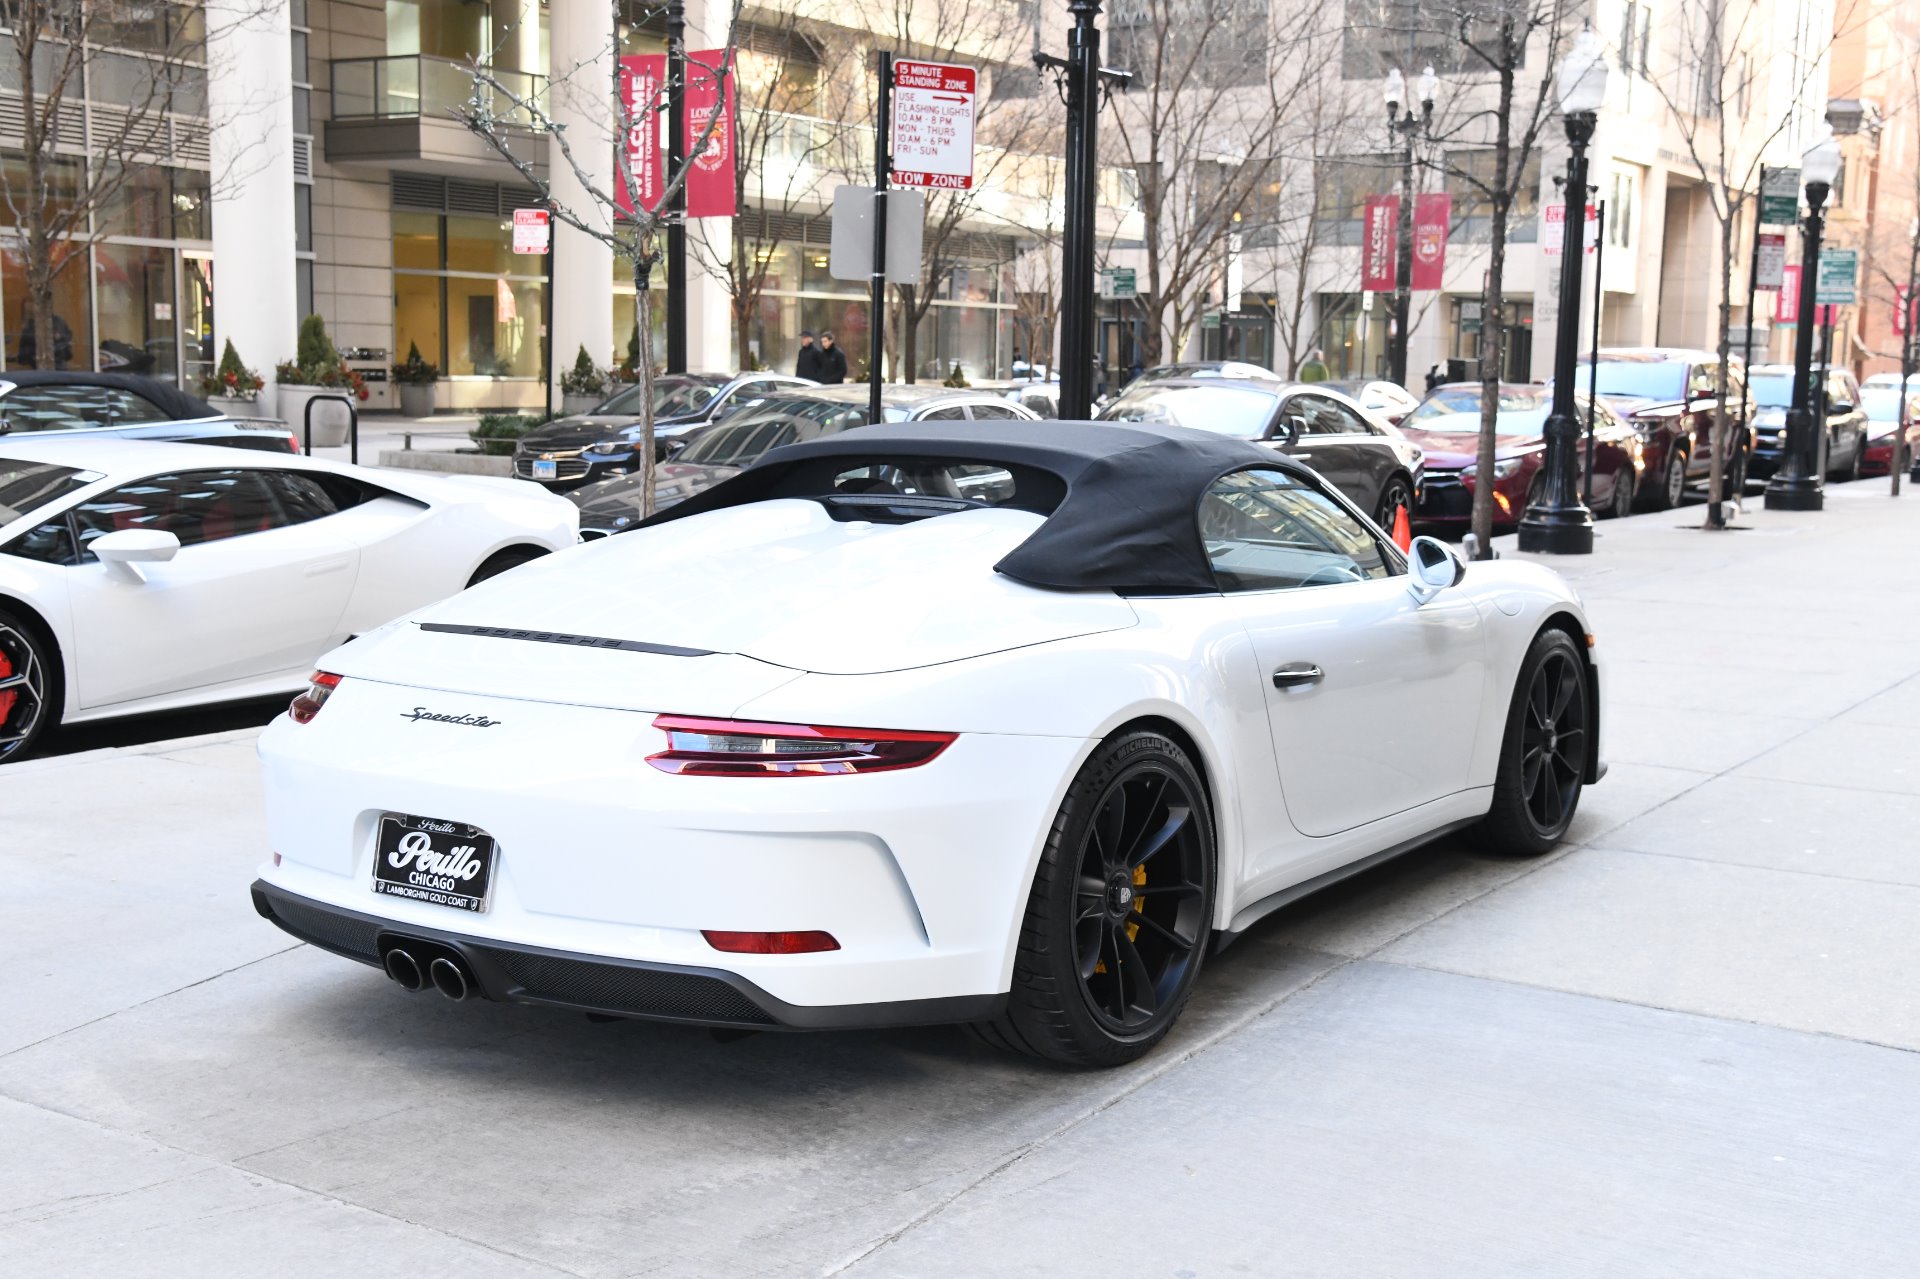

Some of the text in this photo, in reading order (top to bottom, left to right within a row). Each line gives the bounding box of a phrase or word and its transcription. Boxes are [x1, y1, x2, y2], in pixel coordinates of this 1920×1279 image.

[899, 64, 943, 78] 15 MINUTE
[899, 76, 968, 91] STANDING ZONE
[898, 92, 916, 101] USE
[690, 106, 728, 119] LOYOA
[898, 103, 971, 118] FLASHING LIGHTS
[630, 75, 646, 196] WELCOME
[897, 124, 917, 133] MON
[927, 126, 956, 137] THURS
[645, 123, 653, 160] TOWER
[897, 144, 912, 153] FRI
[919, 146, 939, 156] SUN
[645, 164, 653, 198] WATER
[895, 172, 966, 188] TOW ZONE
[472, 627, 623, 648] PORSCHE
[400, 707, 501, 727] Speedster
[1117, 738, 1161, 761] MICHELIN
[417, 819, 456, 834] Perillo
[388, 831, 481, 880] Perillo
[408, 871, 455, 891] CHICAGO
[386, 884, 468, 908] LAMBORGHINI GOLD COAST
